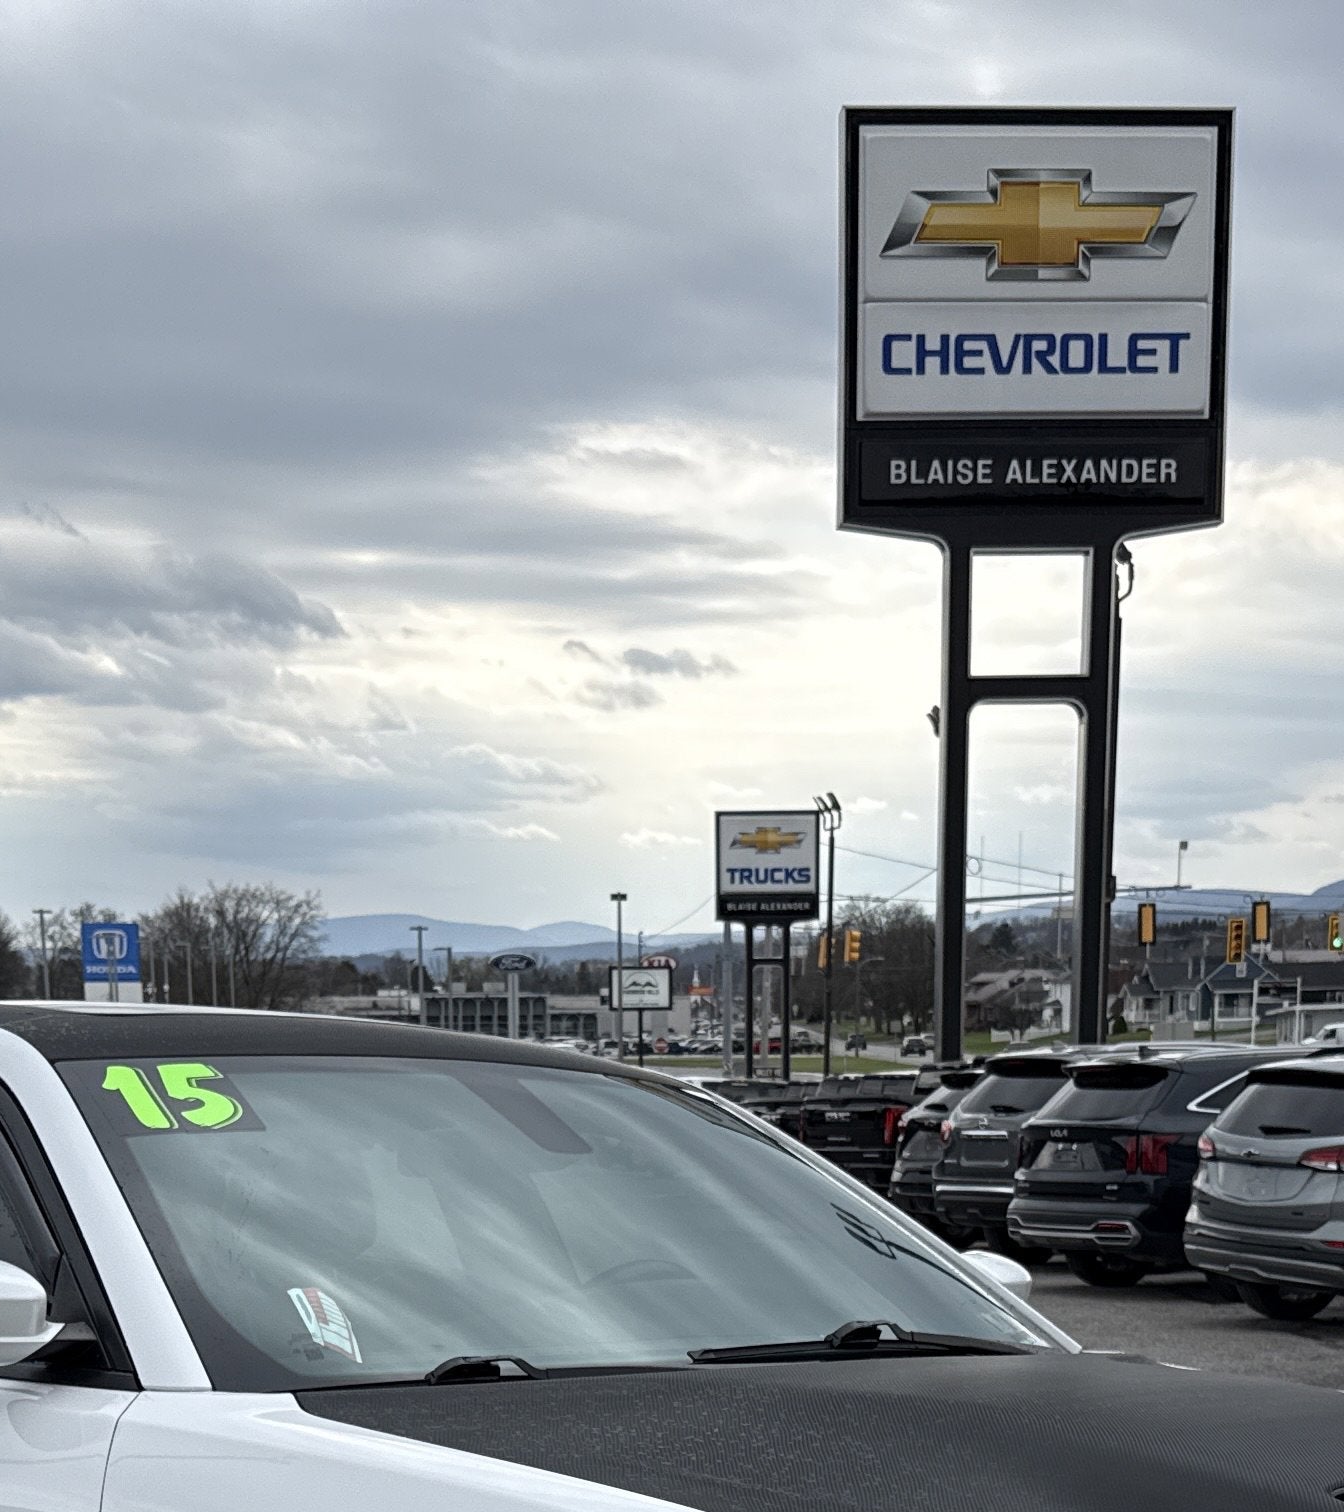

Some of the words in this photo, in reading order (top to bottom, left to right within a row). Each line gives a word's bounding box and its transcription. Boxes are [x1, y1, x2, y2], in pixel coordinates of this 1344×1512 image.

[882, 332, 1191, 375] CHEVROLET
[889, 458, 993, 485] BLAISE
[1005, 458, 1178, 485] ALEXANDER
[726, 867, 812, 885] TRUCKS
[726, 902, 758, 911] BLAISE
[760, 902, 811, 911] ALEXANDER
[102, 1062, 244, 1130] 15
